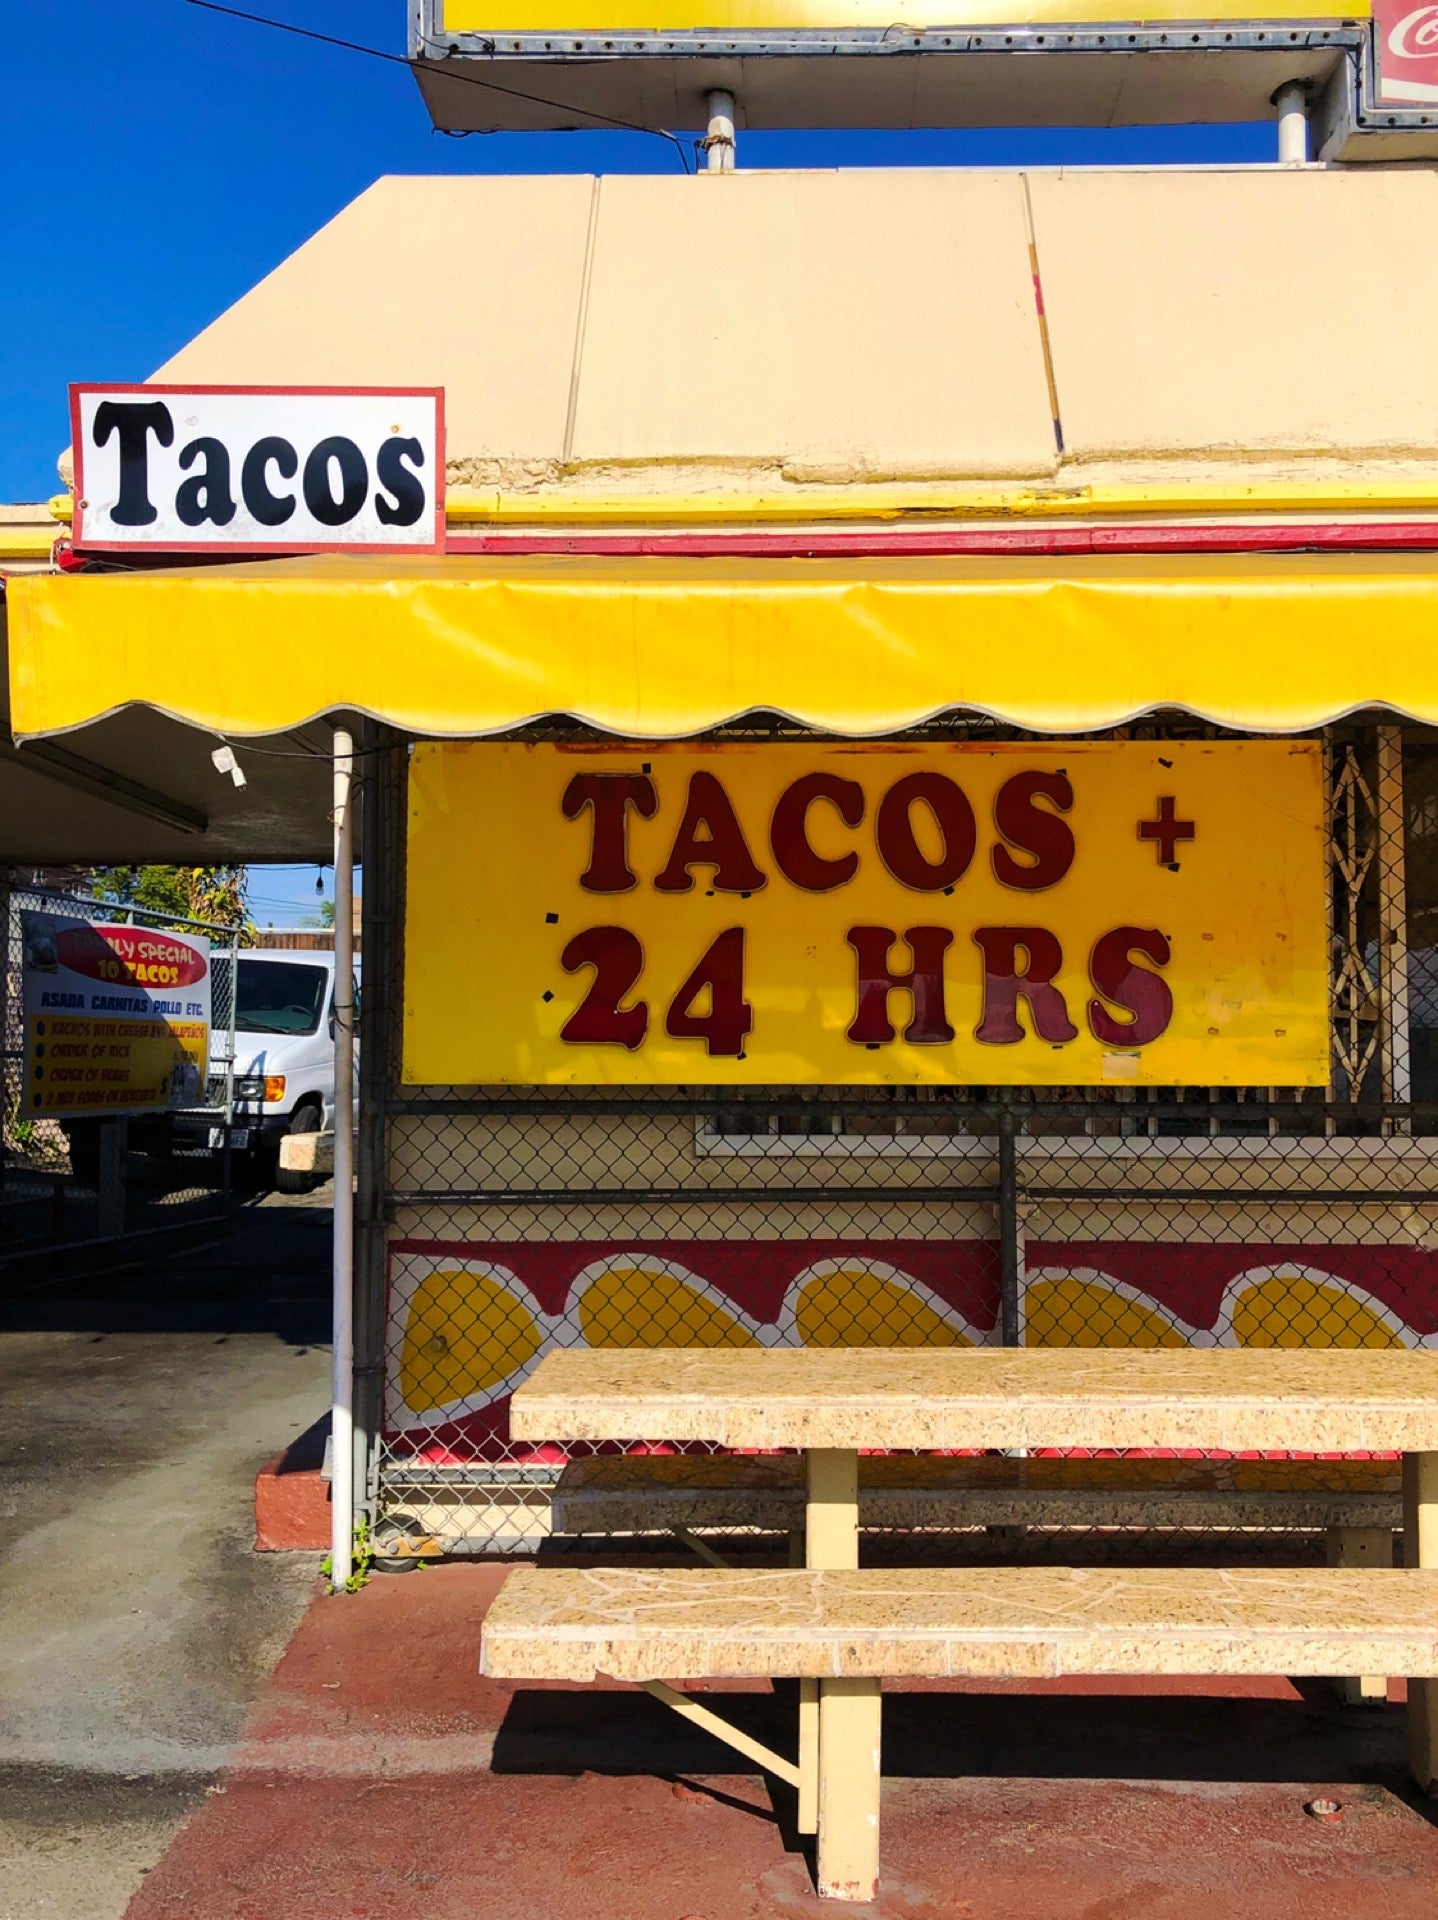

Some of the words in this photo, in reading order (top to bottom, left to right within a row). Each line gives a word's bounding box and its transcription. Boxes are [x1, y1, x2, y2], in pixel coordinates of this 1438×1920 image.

[93, 401, 425, 526] Tacos
[561, 770, 1075, 892] TACOS
[1136, 796, 1195, 866] +
[137, 941, 195, 965] SPECIAL
[98, 959, 120, 980] 10
[124, 961, 179, 984] TACOS
[560, 926, 752, 1056] 24
[845, 926, 1173, 1047] HRS
[41, 992, 85, 1010] ASADA
[91, 996, 148, 1013] CARNITAS
[153, 1000, 182, 1016] POLLO
[186, 1002, 203, 1016] ETC.
[51, 1021, 90, 1037] NACHOS
[93, 1023, 116, 1037] WITH
[50, 1043, 89, 1058] ORDER
[92, 1043, 107, 1058] OF
[108, 1044, 132, 1058] RICE
[49, 1068, 84, 1082] ORDER
[85, 1068, 99, 1082] OF
[100, 1068, 130, 1082] BEANS
